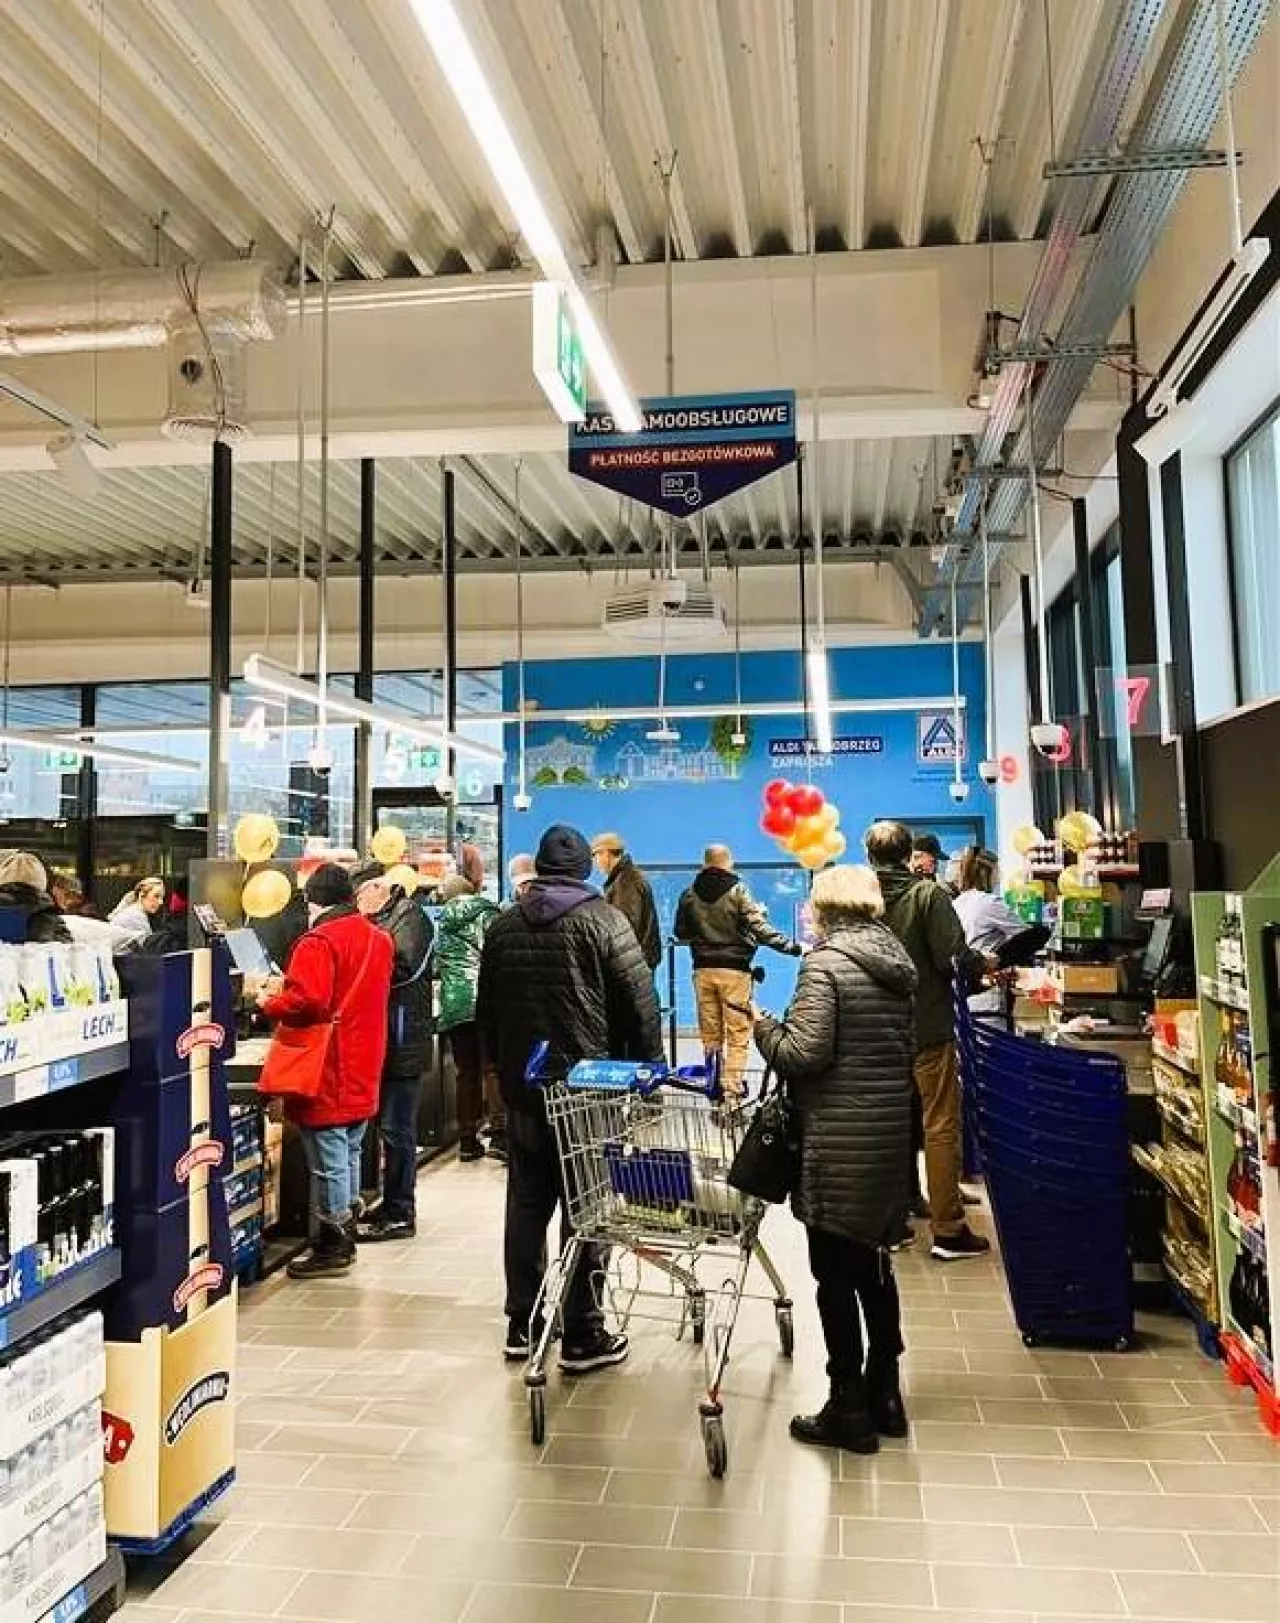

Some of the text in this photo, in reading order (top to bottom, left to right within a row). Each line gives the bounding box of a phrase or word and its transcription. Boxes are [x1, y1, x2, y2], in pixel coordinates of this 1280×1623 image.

[662, 444, 776, 464] BEZGOTÓWKOWA
[1114, 676, 1149, 724] 7
[244, 706, 270, 749] 4
[465, 770, 484, 797] 6
[1000, 755, 1020, 784] 9
[82, 1013, 116, 1040] LECH
